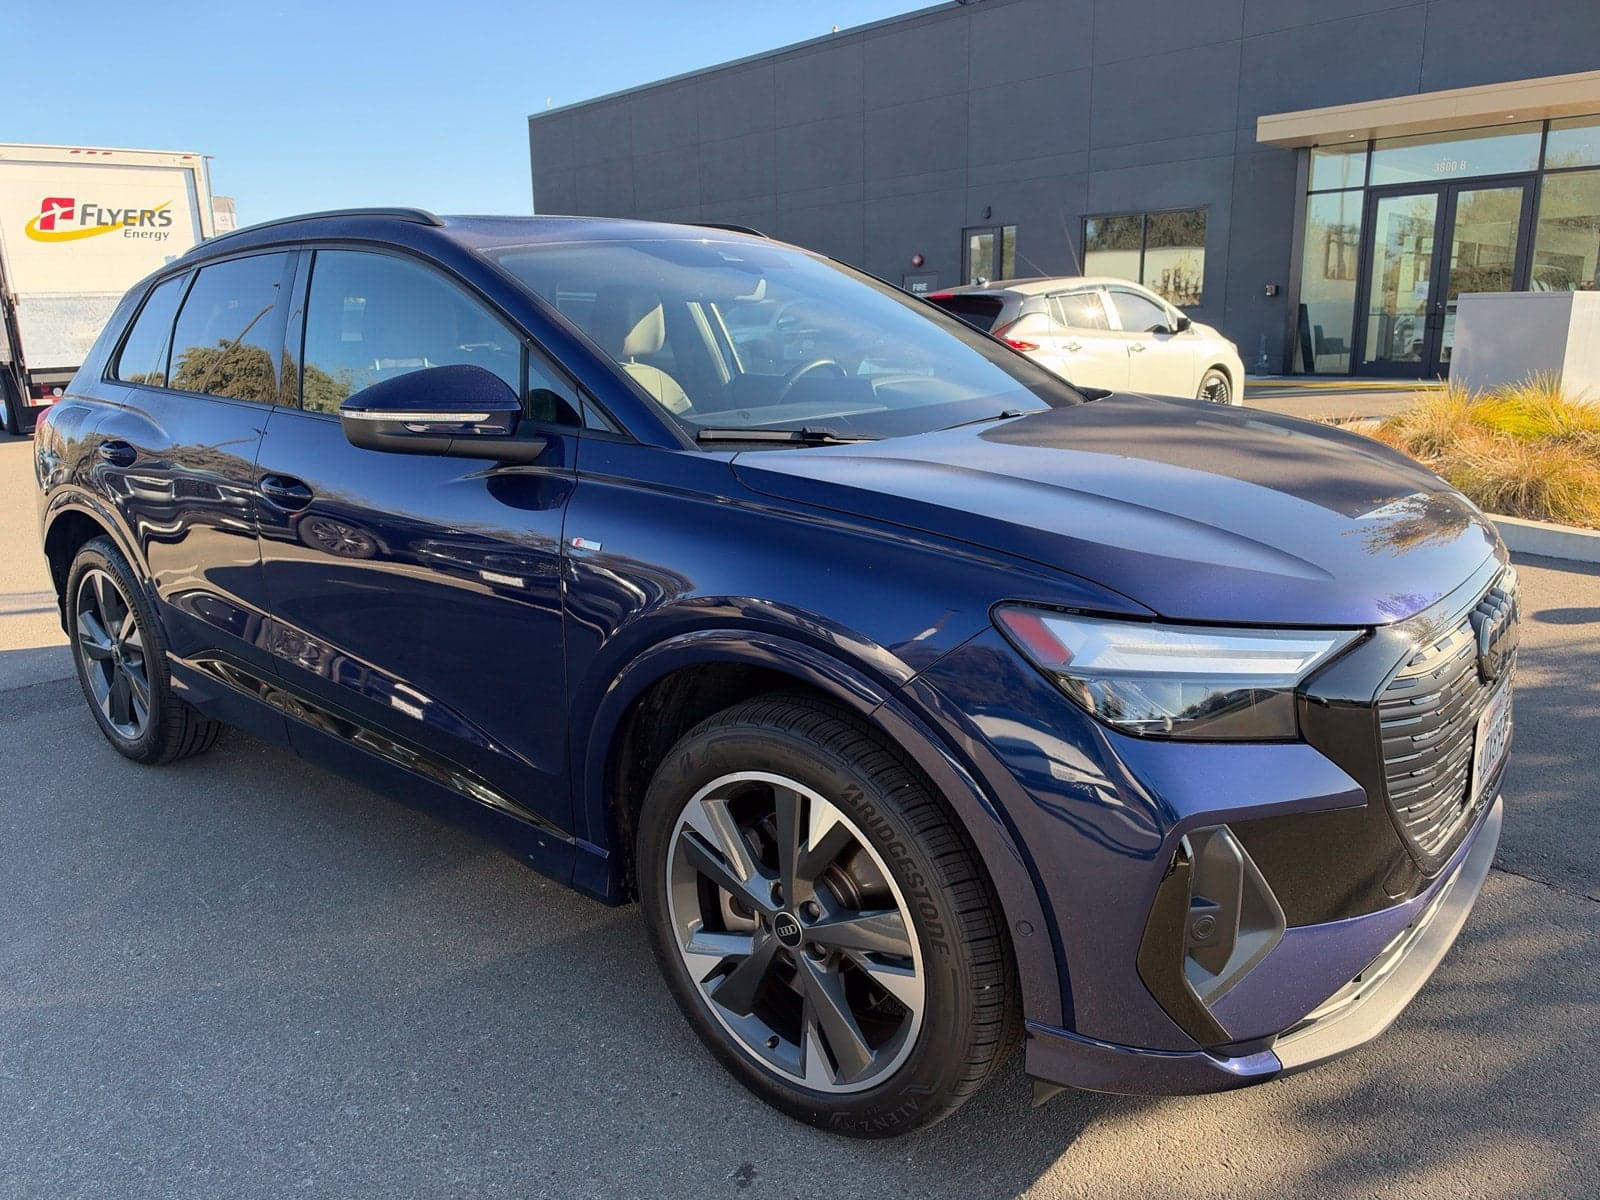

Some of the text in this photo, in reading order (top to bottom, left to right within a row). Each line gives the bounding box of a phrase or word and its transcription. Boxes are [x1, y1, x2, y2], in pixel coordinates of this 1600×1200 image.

[80, 203, 173, 227] FLYERS
[123, 229, 170, 241] Energy
[840, 783, 950, 954] BRIDGESTONE
